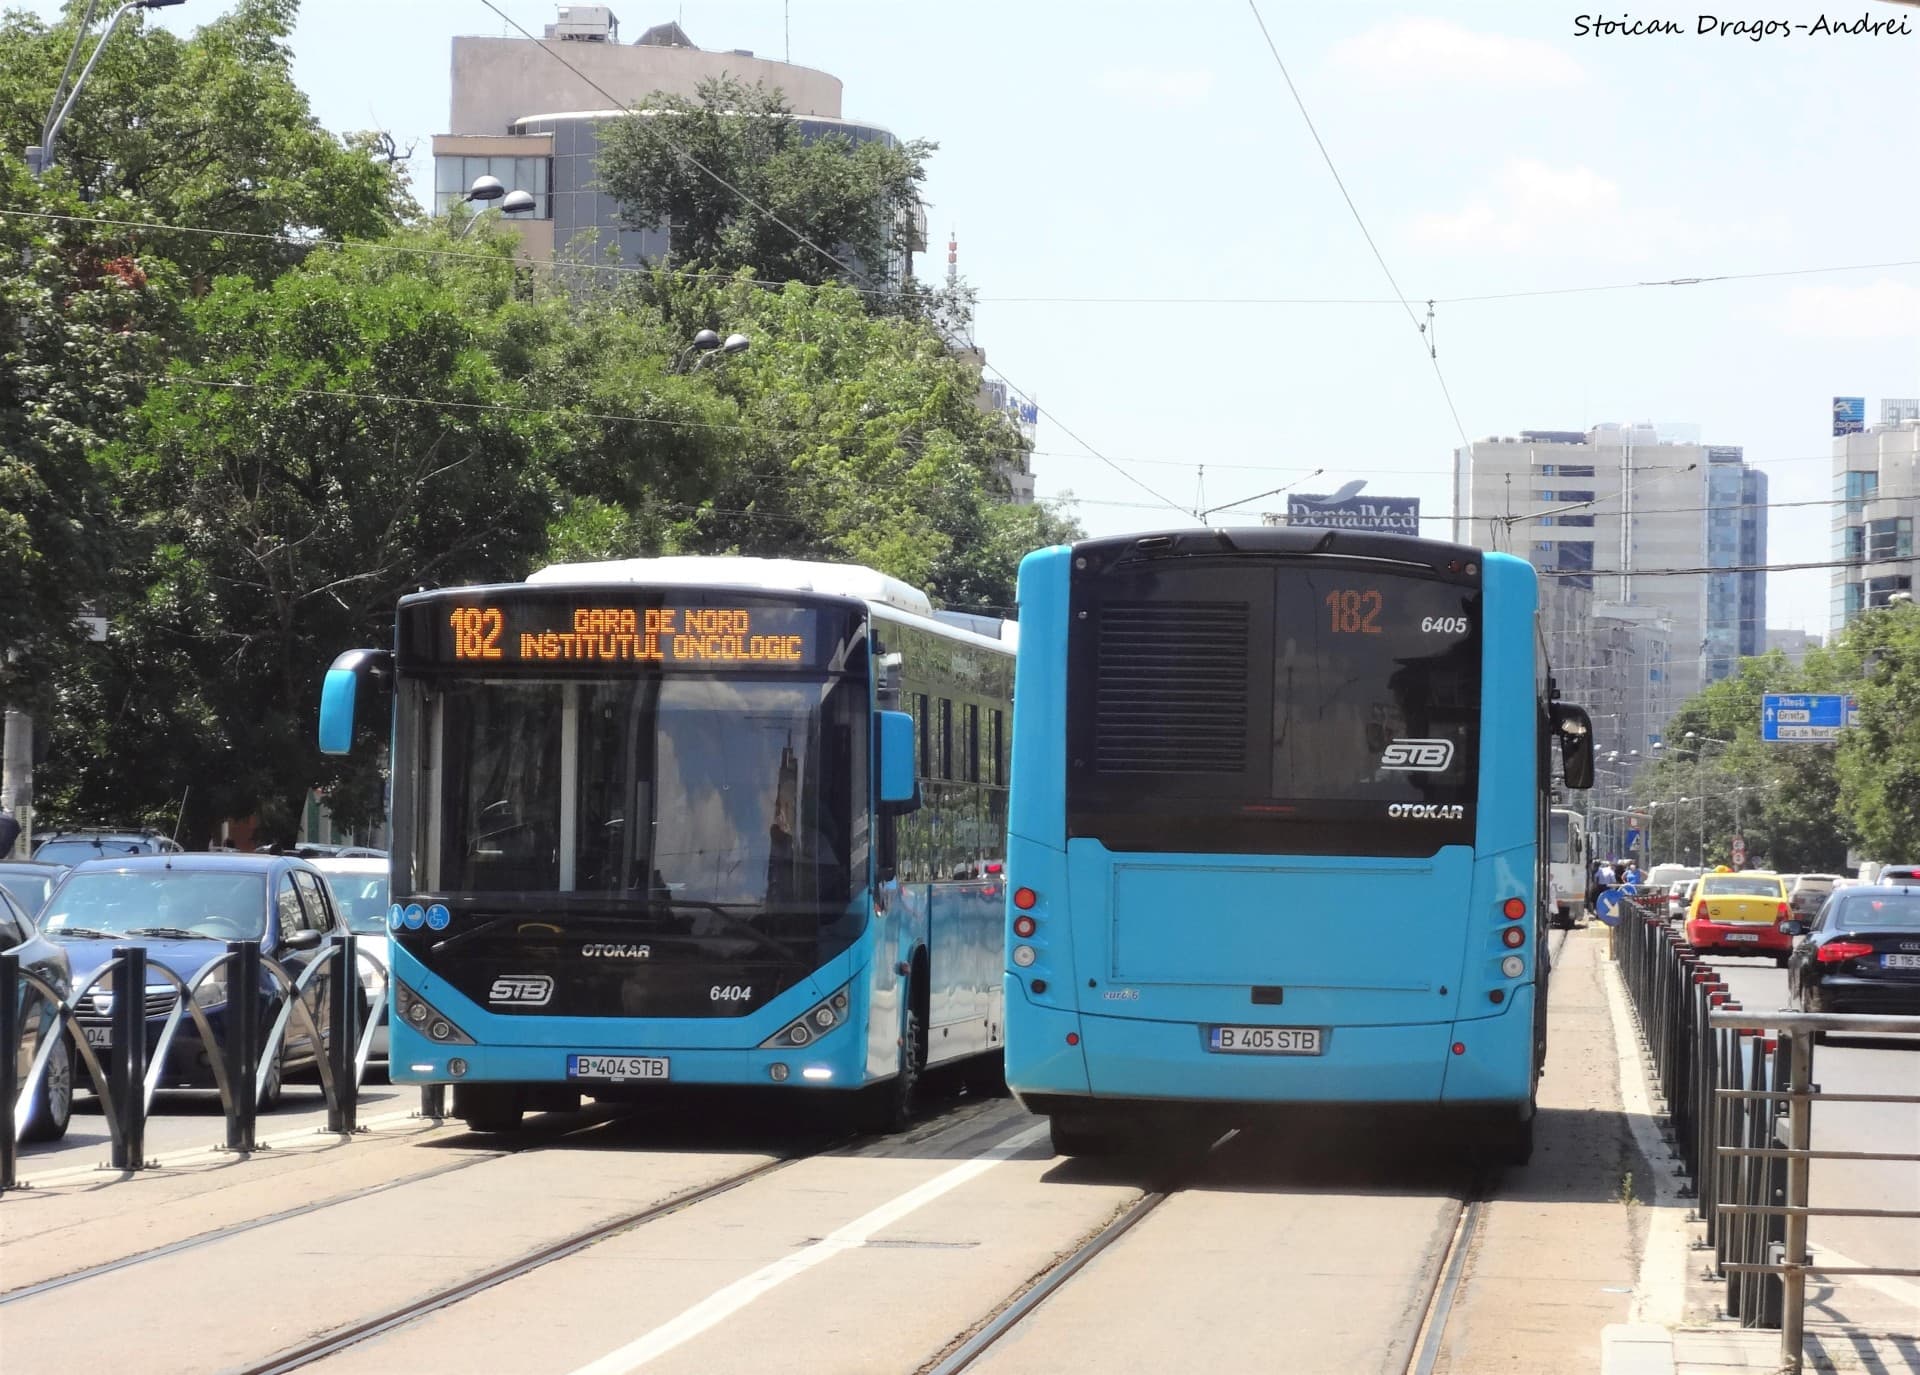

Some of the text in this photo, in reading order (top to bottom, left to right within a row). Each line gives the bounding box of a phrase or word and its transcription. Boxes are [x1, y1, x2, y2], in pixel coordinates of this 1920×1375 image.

[574, 608, 750, 634] GARA DE NORD
[1326, 589, 1383, 633] 182
[450, 607, 503, 659] 182
[1421, 616, 1467, 633] 6405
[519, 633, 802, 661] INSTITUTUL ONCOLOGIC
[1381, 742, 1449, 766] STB
[1388, 803, 1464, 819] OTOKAR
[582, 943, 651, 959] OTOKAR
[489, 977, 552, 1002] STB
[710, 985, 752, 1001] 6404
[1221, 1030, 1234, 1047] B
[1241, 1031, 1274, 1048] 405
[1277, 1031, 1315, 1049] STB
[578, 1058, 590, 1074] B
[596, 1059, 626, 1075] 404
[629, 1060, 664, 1076] STB
